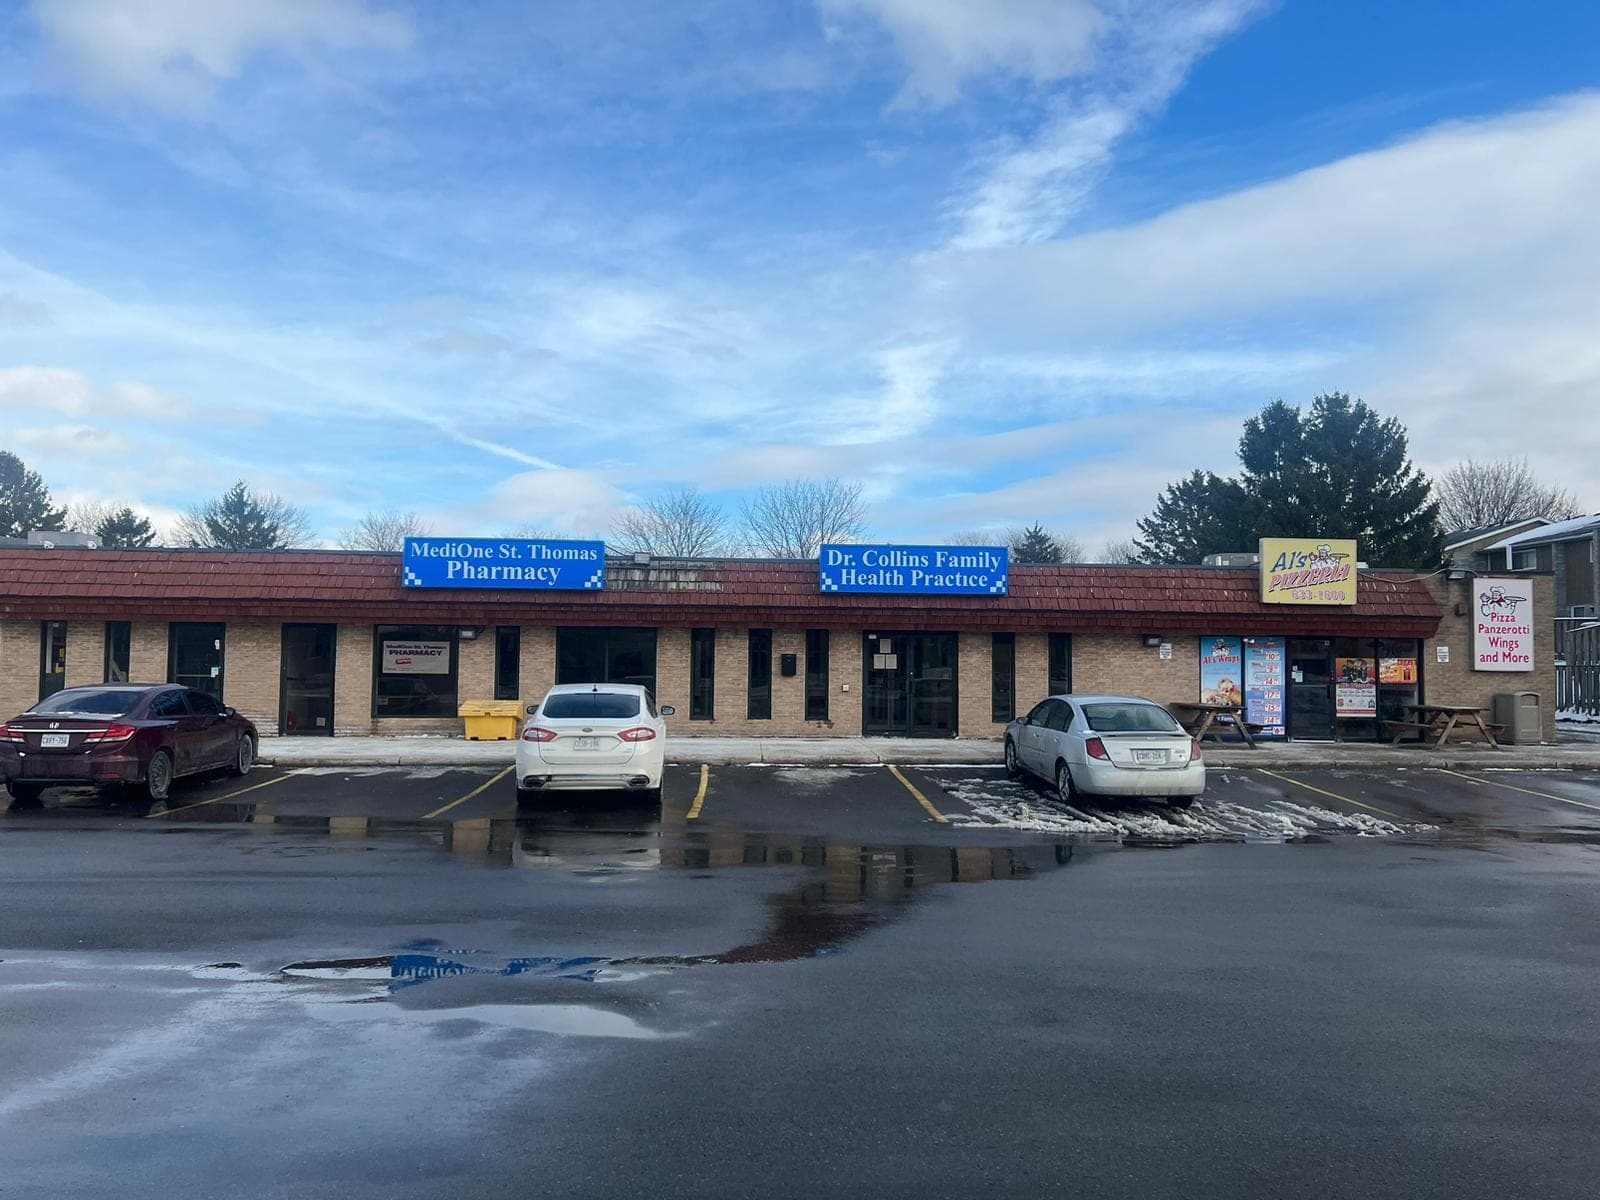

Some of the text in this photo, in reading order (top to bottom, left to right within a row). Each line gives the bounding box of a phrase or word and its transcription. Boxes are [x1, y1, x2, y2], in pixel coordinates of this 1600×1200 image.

[411, 542, 598, 561] MediOne St. Thomas
[827, 550, 1001, 572] Dr. Collins Family
[1270, 551, 1308, 572] Al's
[446, 560, 562, 586] Pharmacy
[840, 569, 989, 587] Health Practice
[1268, 563, 1351, 592] PIZZERIA
[1490, 612, 1516, 623] Pizza
[1478, 624, 1530, 634] Panzerotti
[1488, 637, 1519, 652] Wings
[1479, 652, 1529, 663] and More
